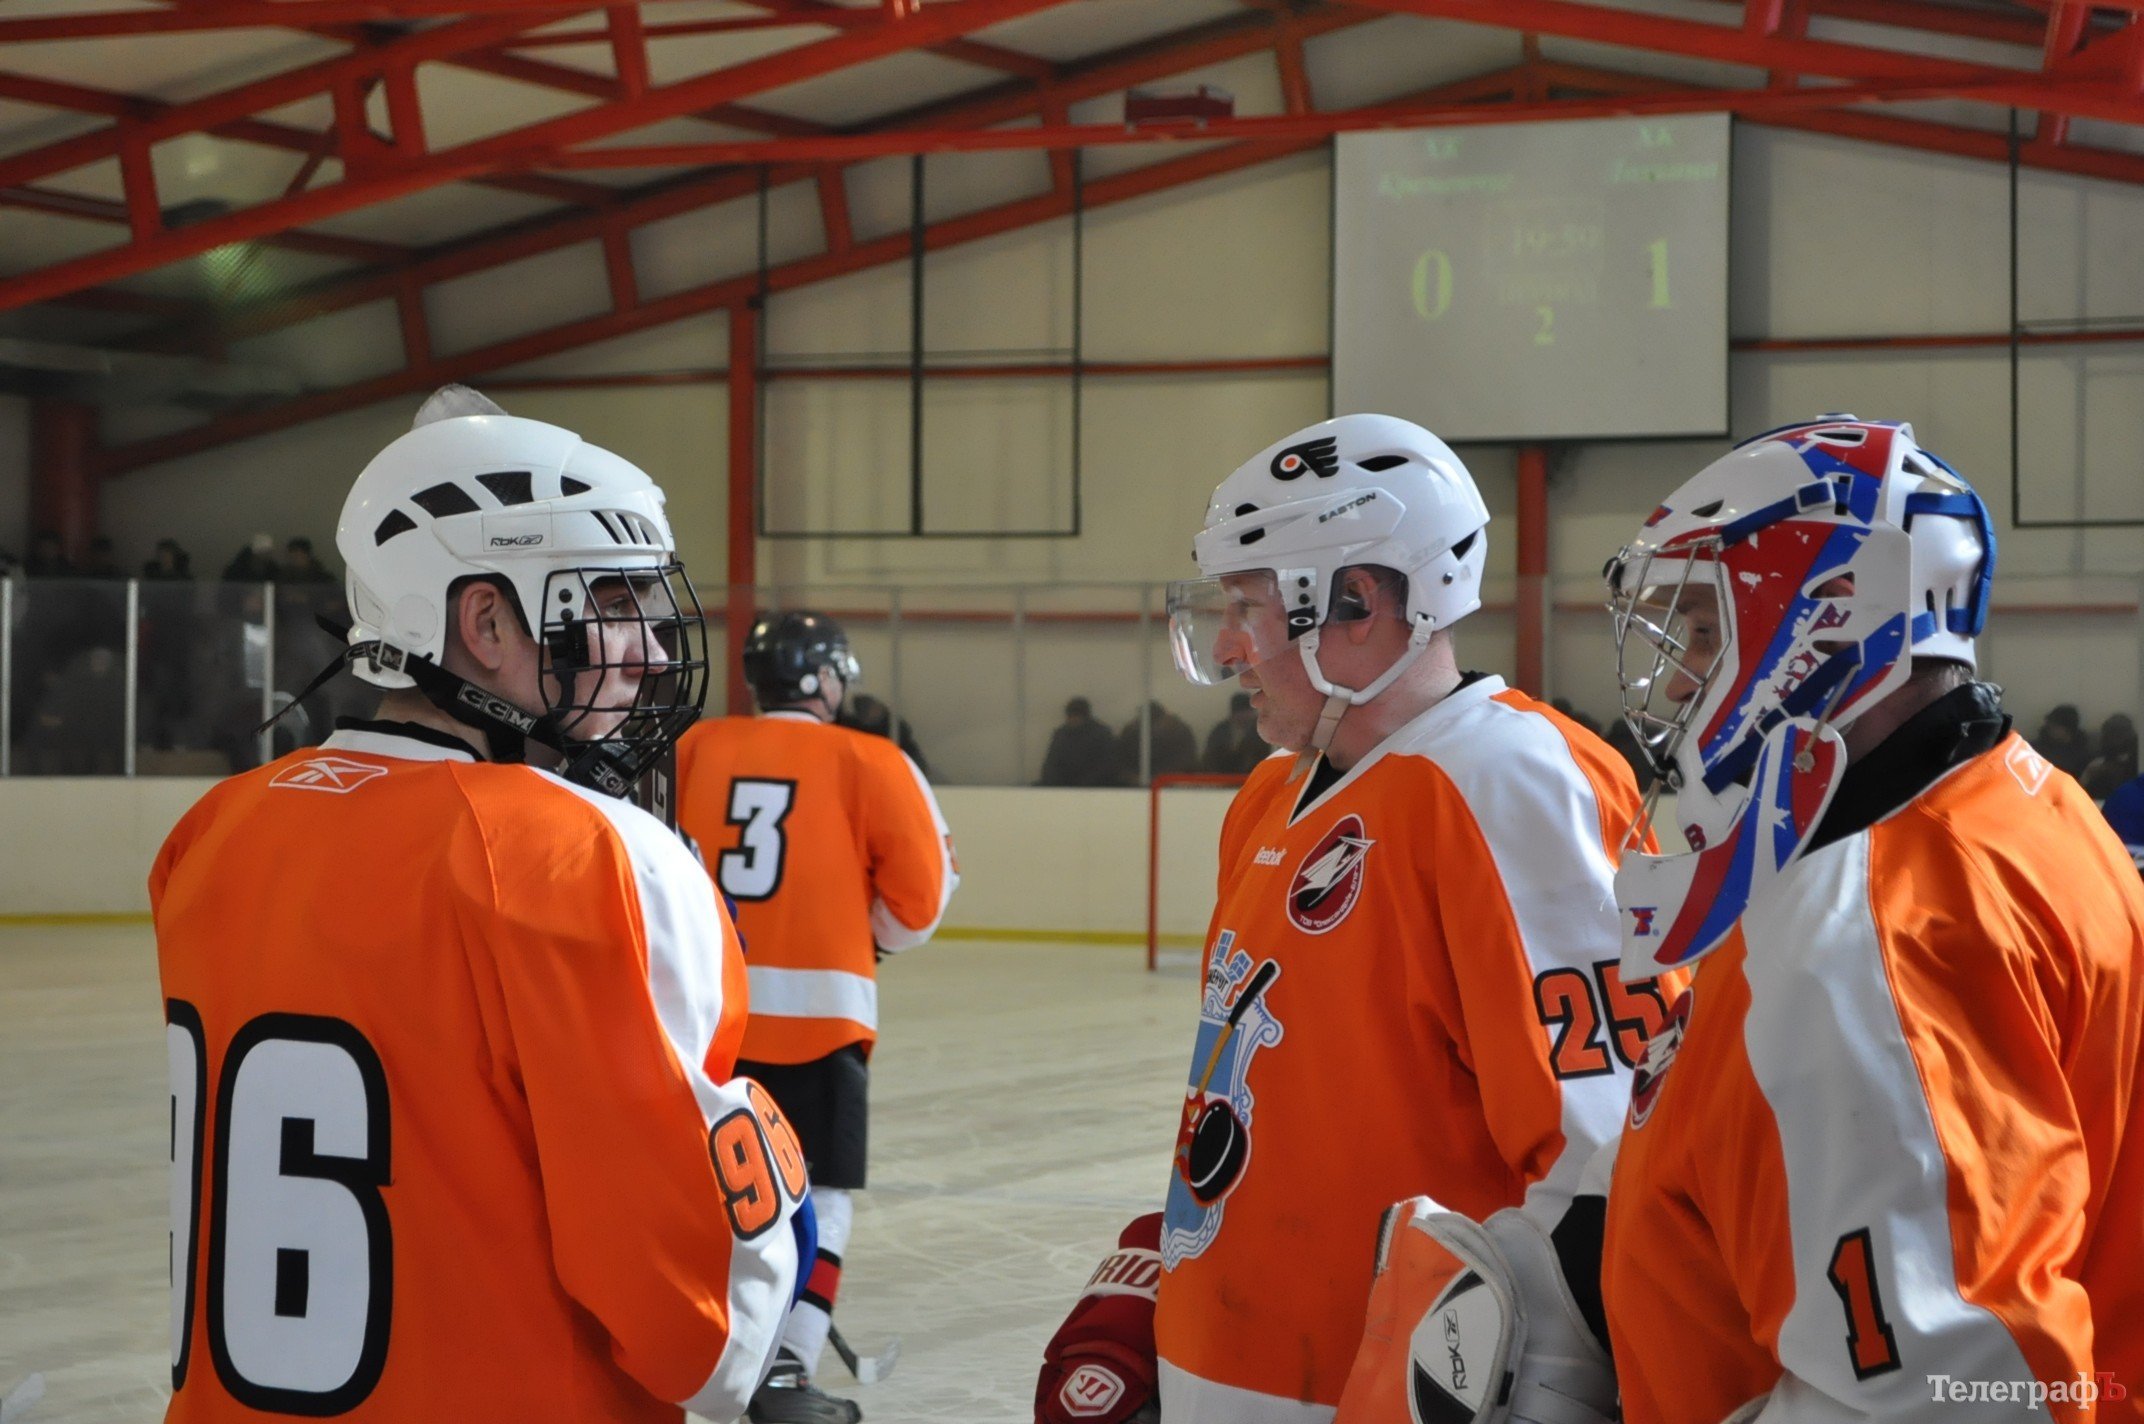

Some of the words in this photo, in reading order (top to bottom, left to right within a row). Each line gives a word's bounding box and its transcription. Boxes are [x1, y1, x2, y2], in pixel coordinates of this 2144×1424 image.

[1412, 248, 1453, 320] 0
[1645, 237, 1671, 309] 1
[1533, 306, 1556, 346] 2
[1319, 492, 1376, 523] EASTON
[457, 681, 538, 735] CCM
[716, 776, 798, 902] 3
[1533, 959, 1670, 1082] 25
[708, 1081, 807, 1241] 96
[1827, 1226, 1902, 1382] 1
